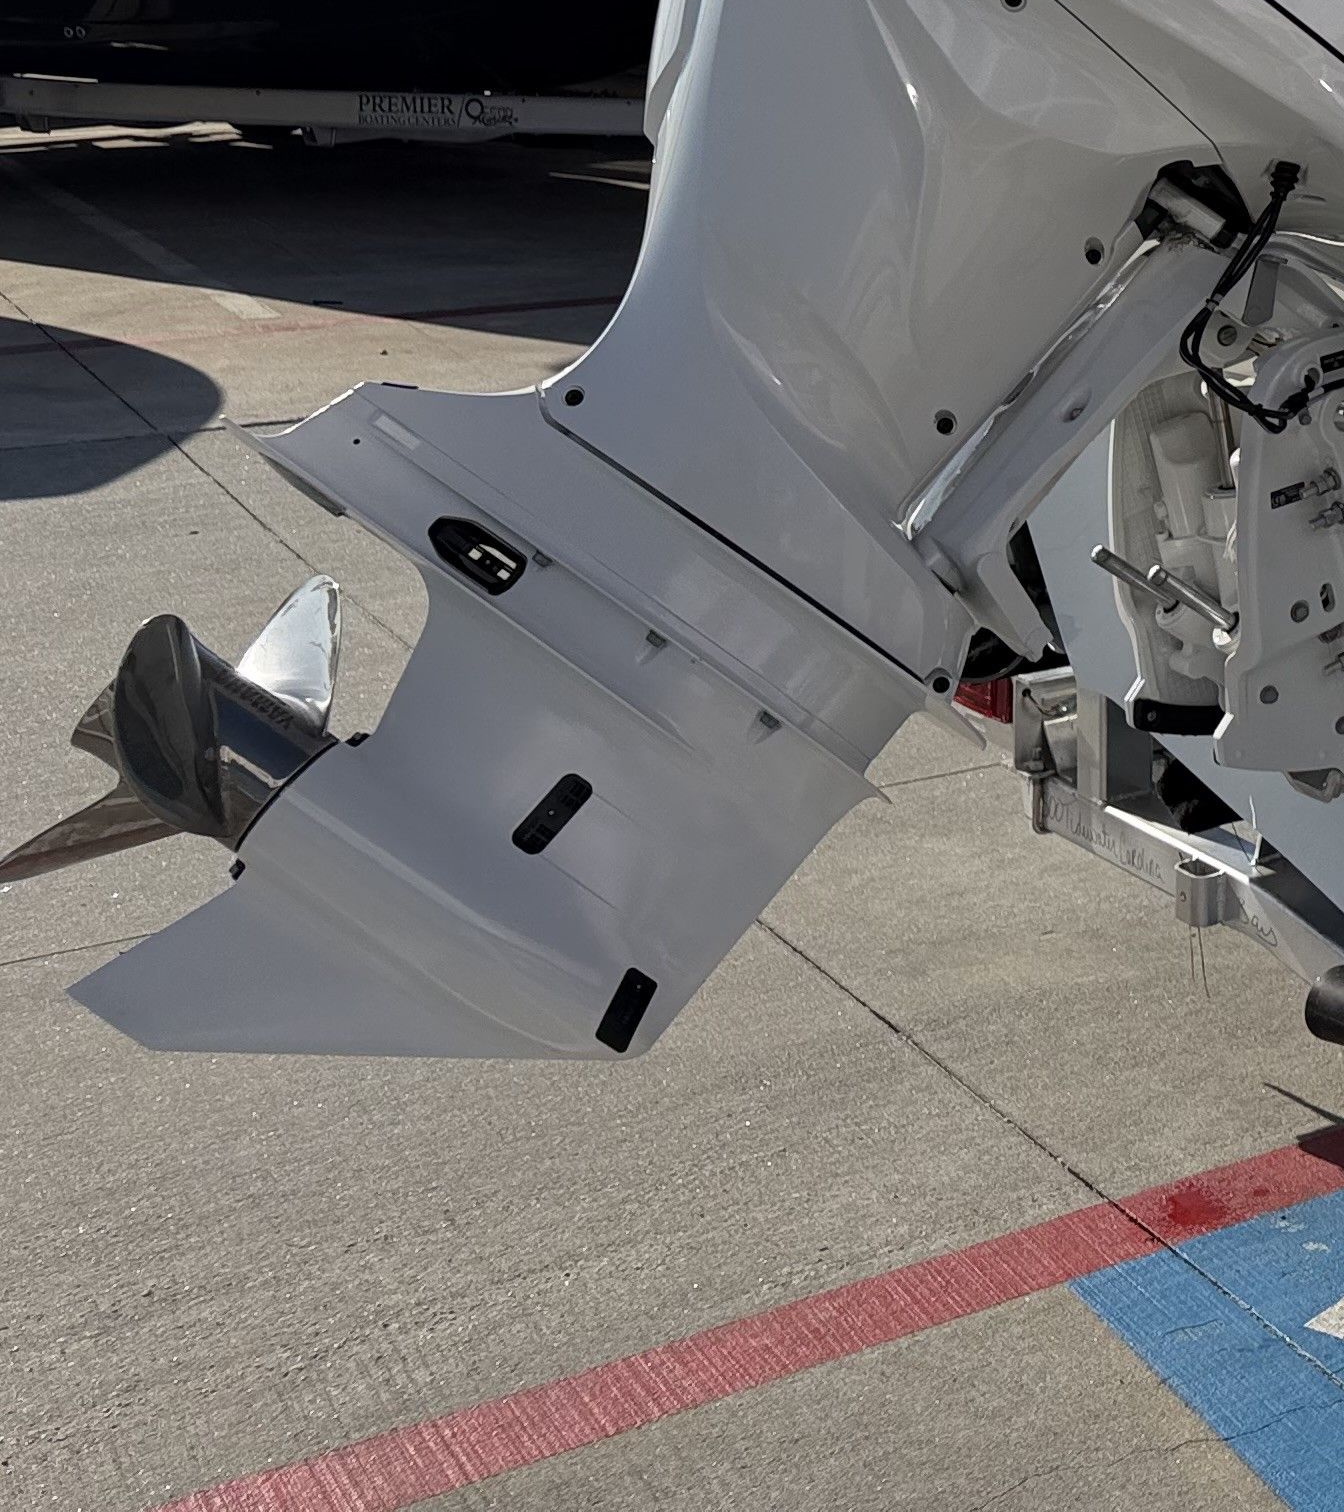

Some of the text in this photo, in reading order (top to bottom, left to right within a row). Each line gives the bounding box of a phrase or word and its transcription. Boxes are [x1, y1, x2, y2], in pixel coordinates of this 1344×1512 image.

[359, 94, 455, 115] PREMIER
[359, 114, 457, 128] BOATING CENTERS
